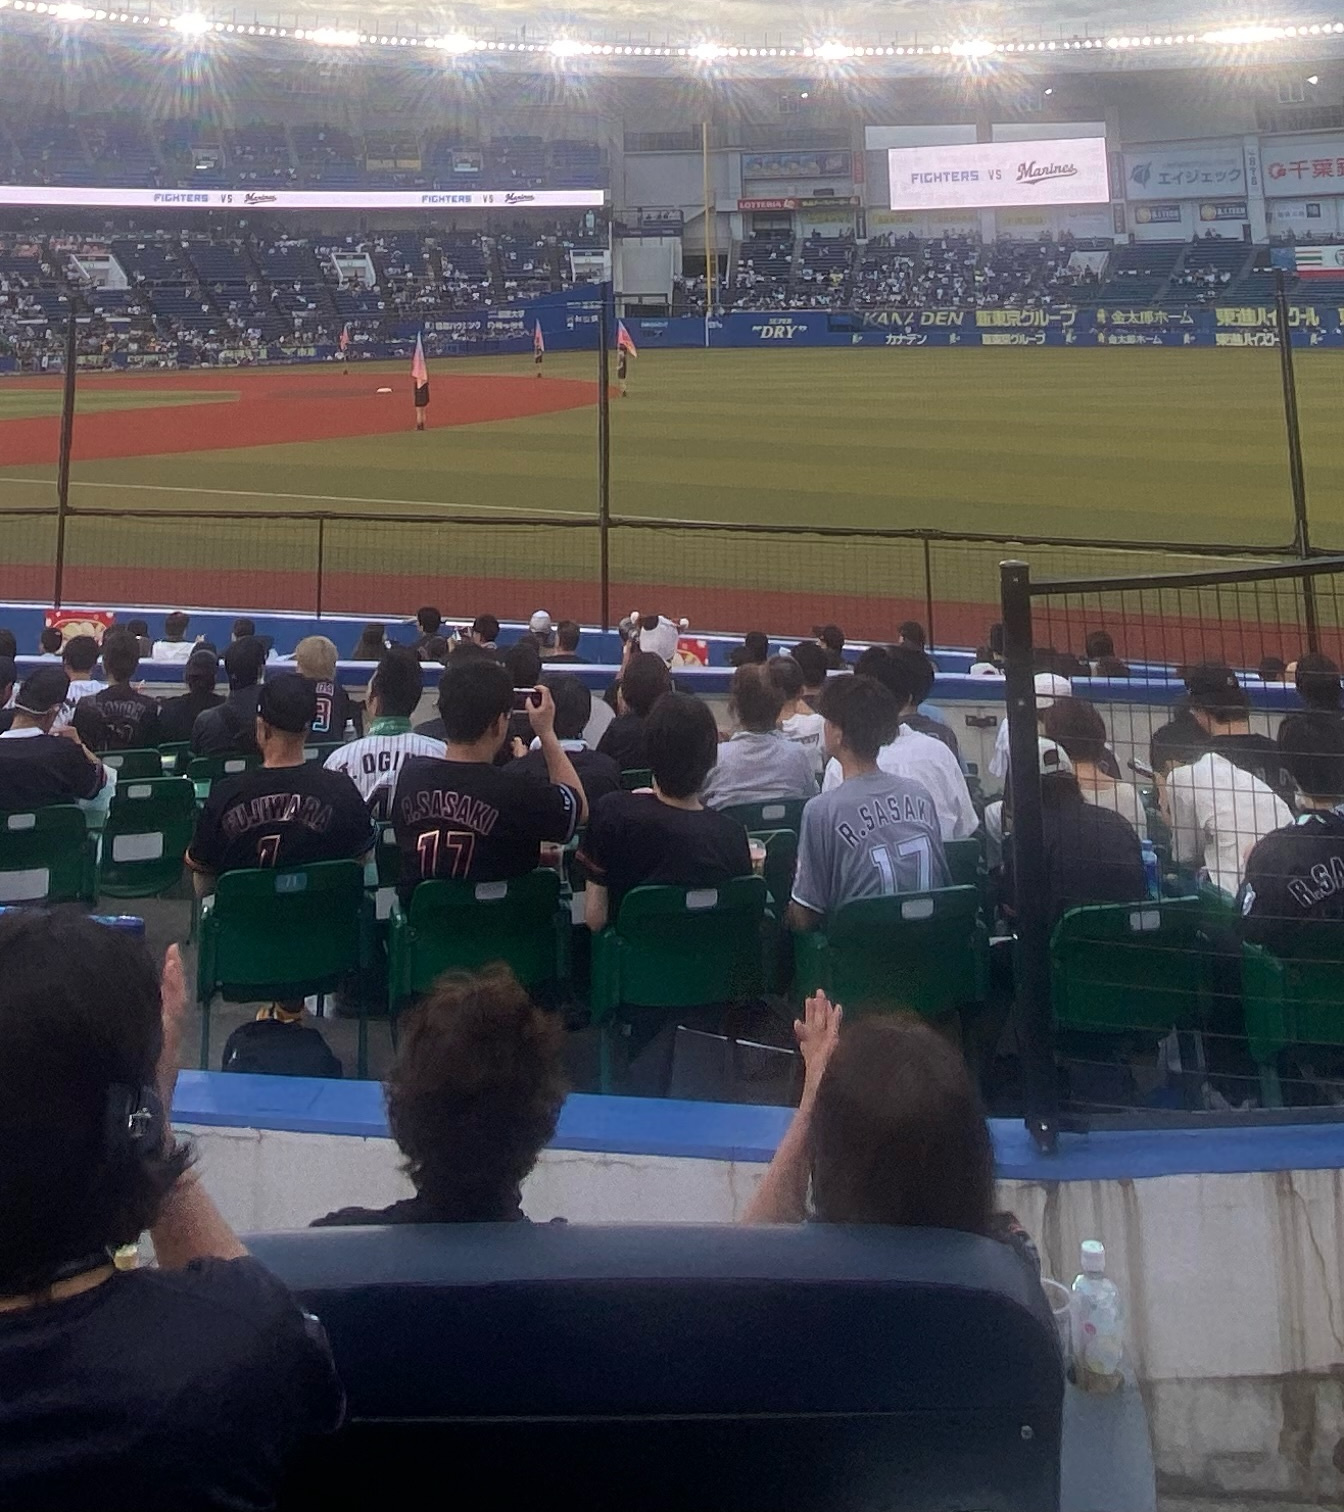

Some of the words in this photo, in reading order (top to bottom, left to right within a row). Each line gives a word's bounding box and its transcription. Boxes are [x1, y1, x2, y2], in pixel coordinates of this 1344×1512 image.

[911, 170, 979, 185] FIGHTERS
[988, 169, 1002, 180] VS
[1016, 160, 1078, 185] Marines
[1158, 169, 1241, 186] エイジェック
[154, 193, 209, 202] FIGHTERS
[221, 194, 232, 203] VS
[422, 195, 471, 203] FIGHTERS
[483, 194, 494, 203] VS
[739, 201, 782, 209] LOTTERIA
[1215, 308, 1320, 326] 東進ハイクール
[885, 334, 927, 345] カナデン
[1215, 333, 1281, 346] 東進ハイスクー
[401, 790, 499, 835] R.SASAKI
[836, 794, 935, 848] R.SASAK
[417, 829, 475, 879] 17
[869, 833, 933, 895] 17
